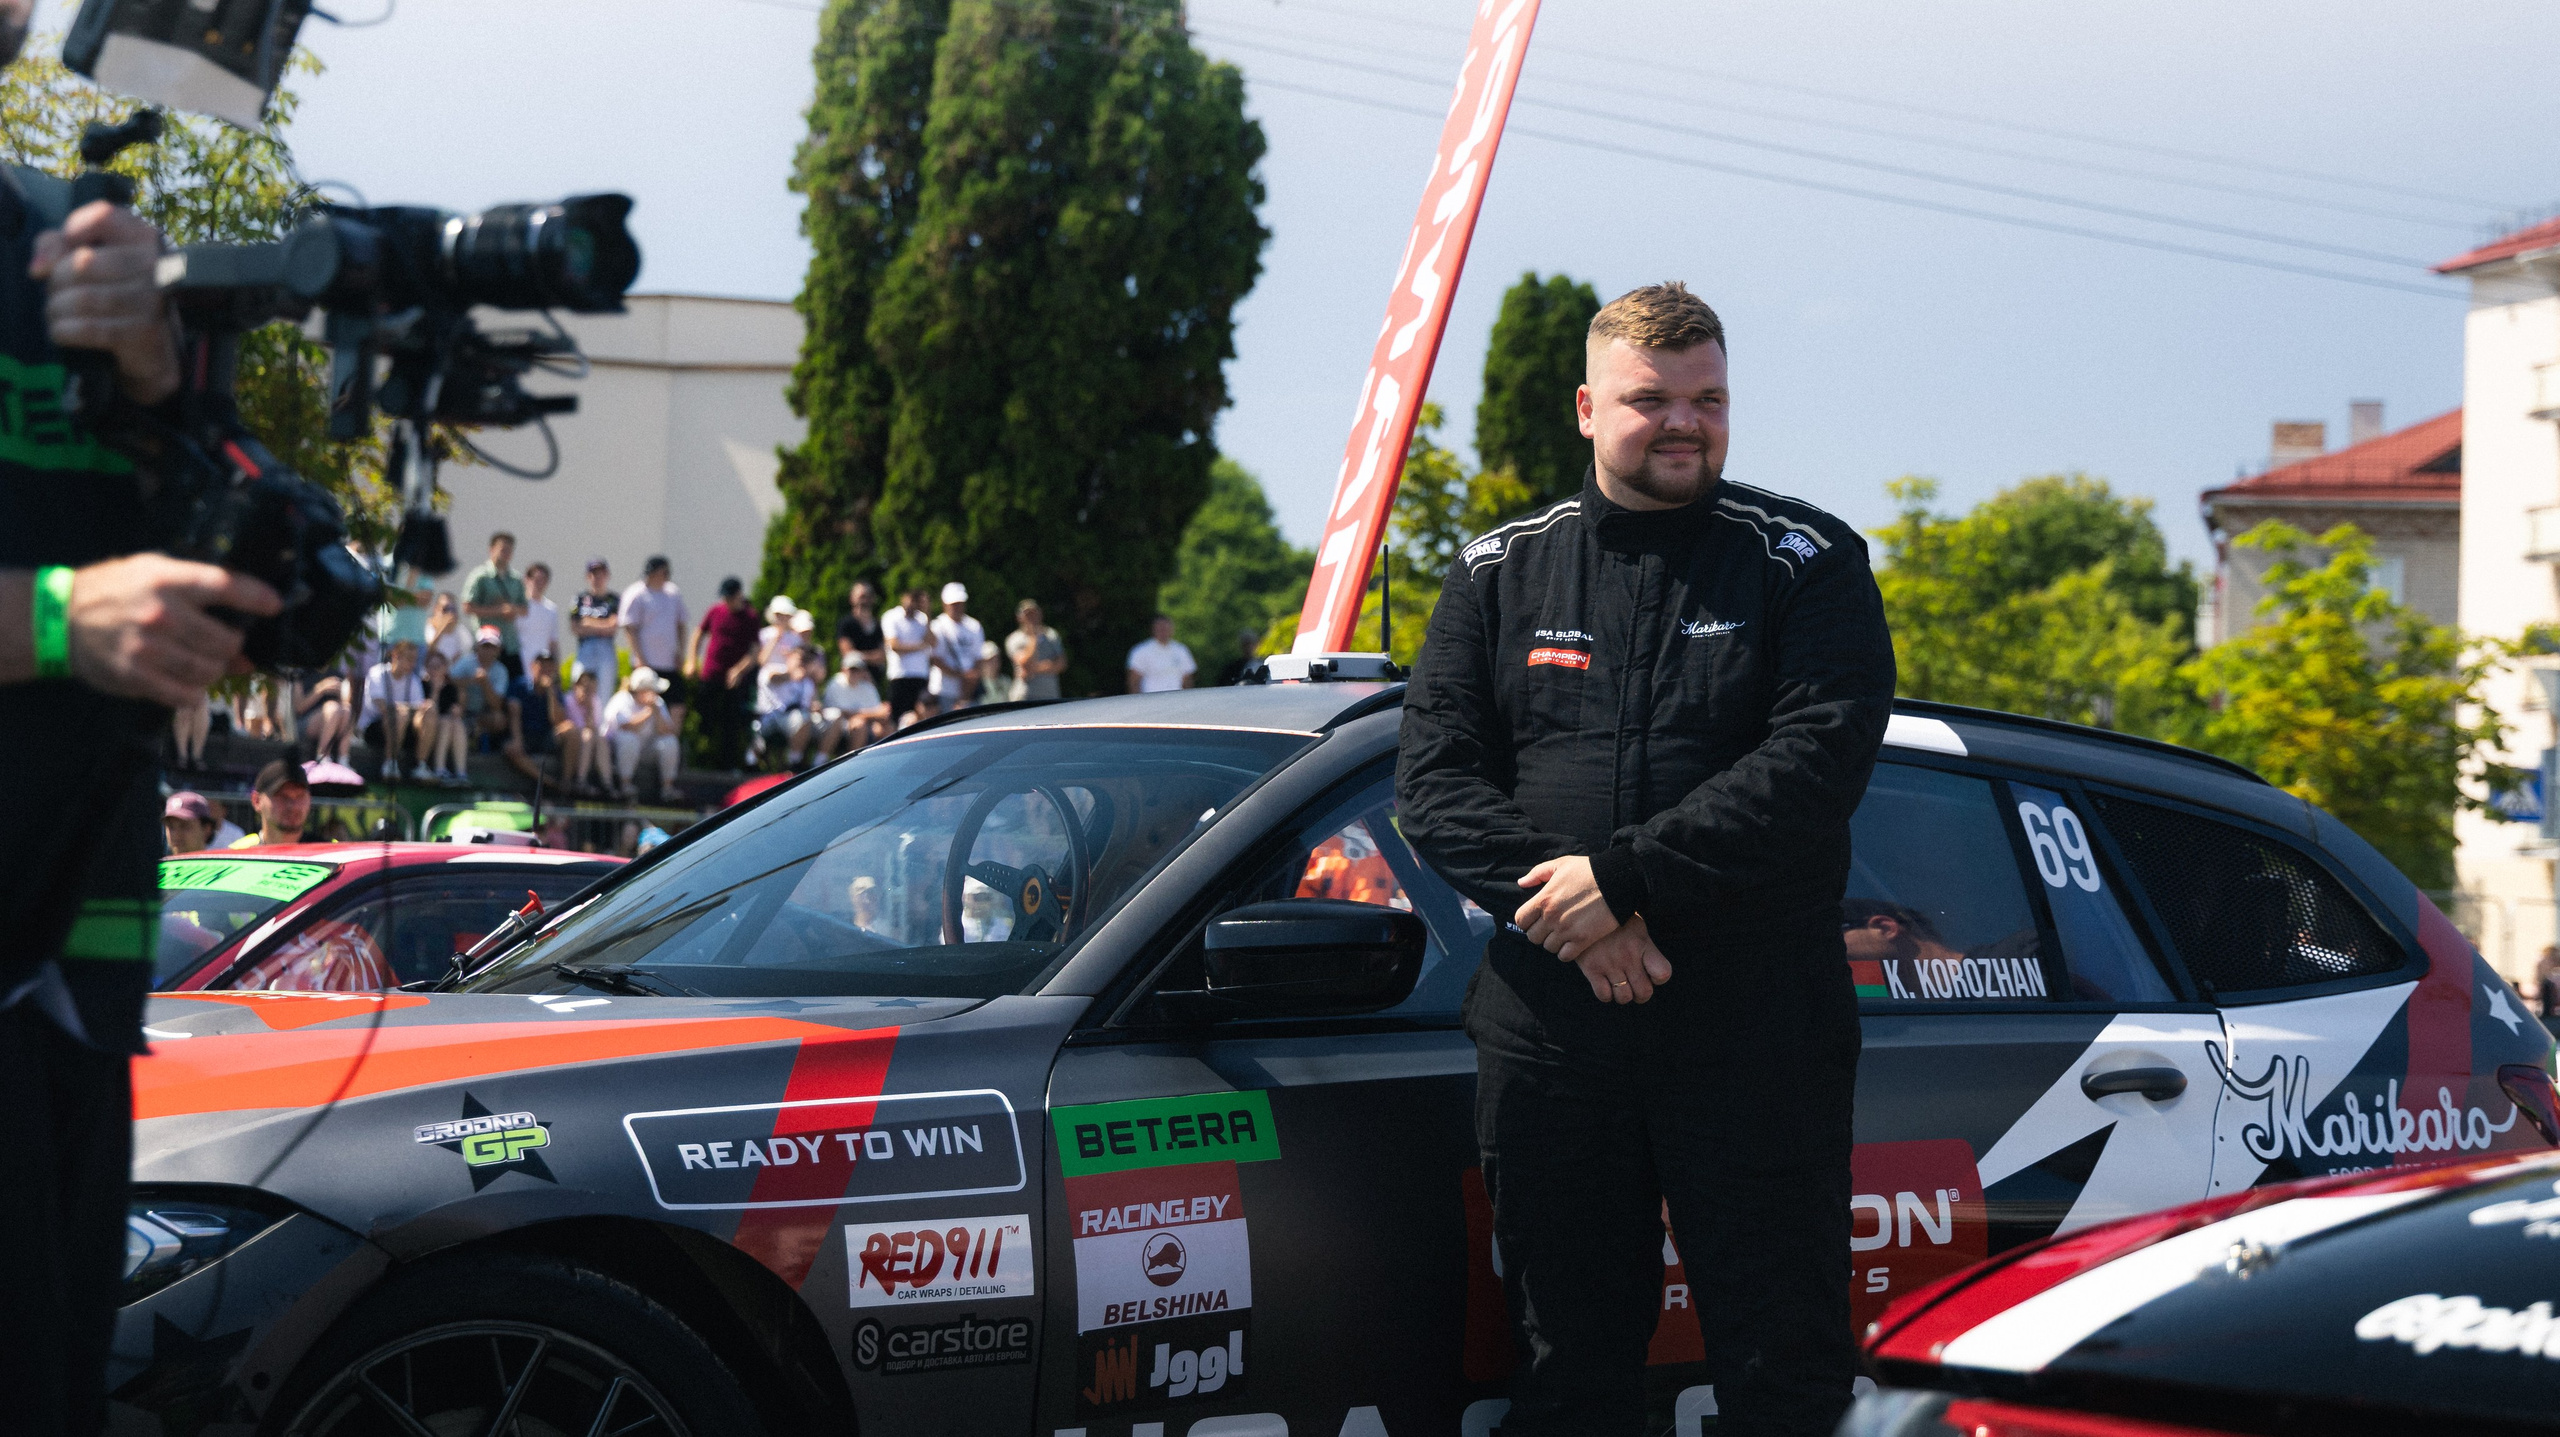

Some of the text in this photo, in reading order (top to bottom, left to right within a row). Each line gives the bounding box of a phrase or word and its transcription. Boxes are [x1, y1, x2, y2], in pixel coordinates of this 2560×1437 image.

[1464, 540, 1502, 564] OMP
[1779, 534, 1815, 558] OMP
[1556, 630, 1594, 642] GLOBAL
[1530, 651, 1587, 663] CHAMPION
[2018, 801, 2100, 893] 69
[1883, 957, 2047, 999] K. KOROZHAN
[2204, 1039, 2518, 1165] Marikaro
[415, 1114, 533, 1143] GRODNO
[463, 1127, 547, 1165] GP
[678, 1125, 984, 1169] READY TO WIN
[898, 1289, 917, 1300] CAR
[919, 1287, 953, 1298] WRAPS
[959, 1285, 1006, 1296] DETAILING
[1103, 1289, 1229, 1326] BELSHINA
[888, 1320, 1028, 1358] carstore
[886, 1360, 916, 1371] ПОДБОР
[924, 1356, 963, 1368] ДОСТАВКА
[964, 1353, 984, 1363] АВТО
[996, 1350, 1027, 1361] ЕВРОПЫ
